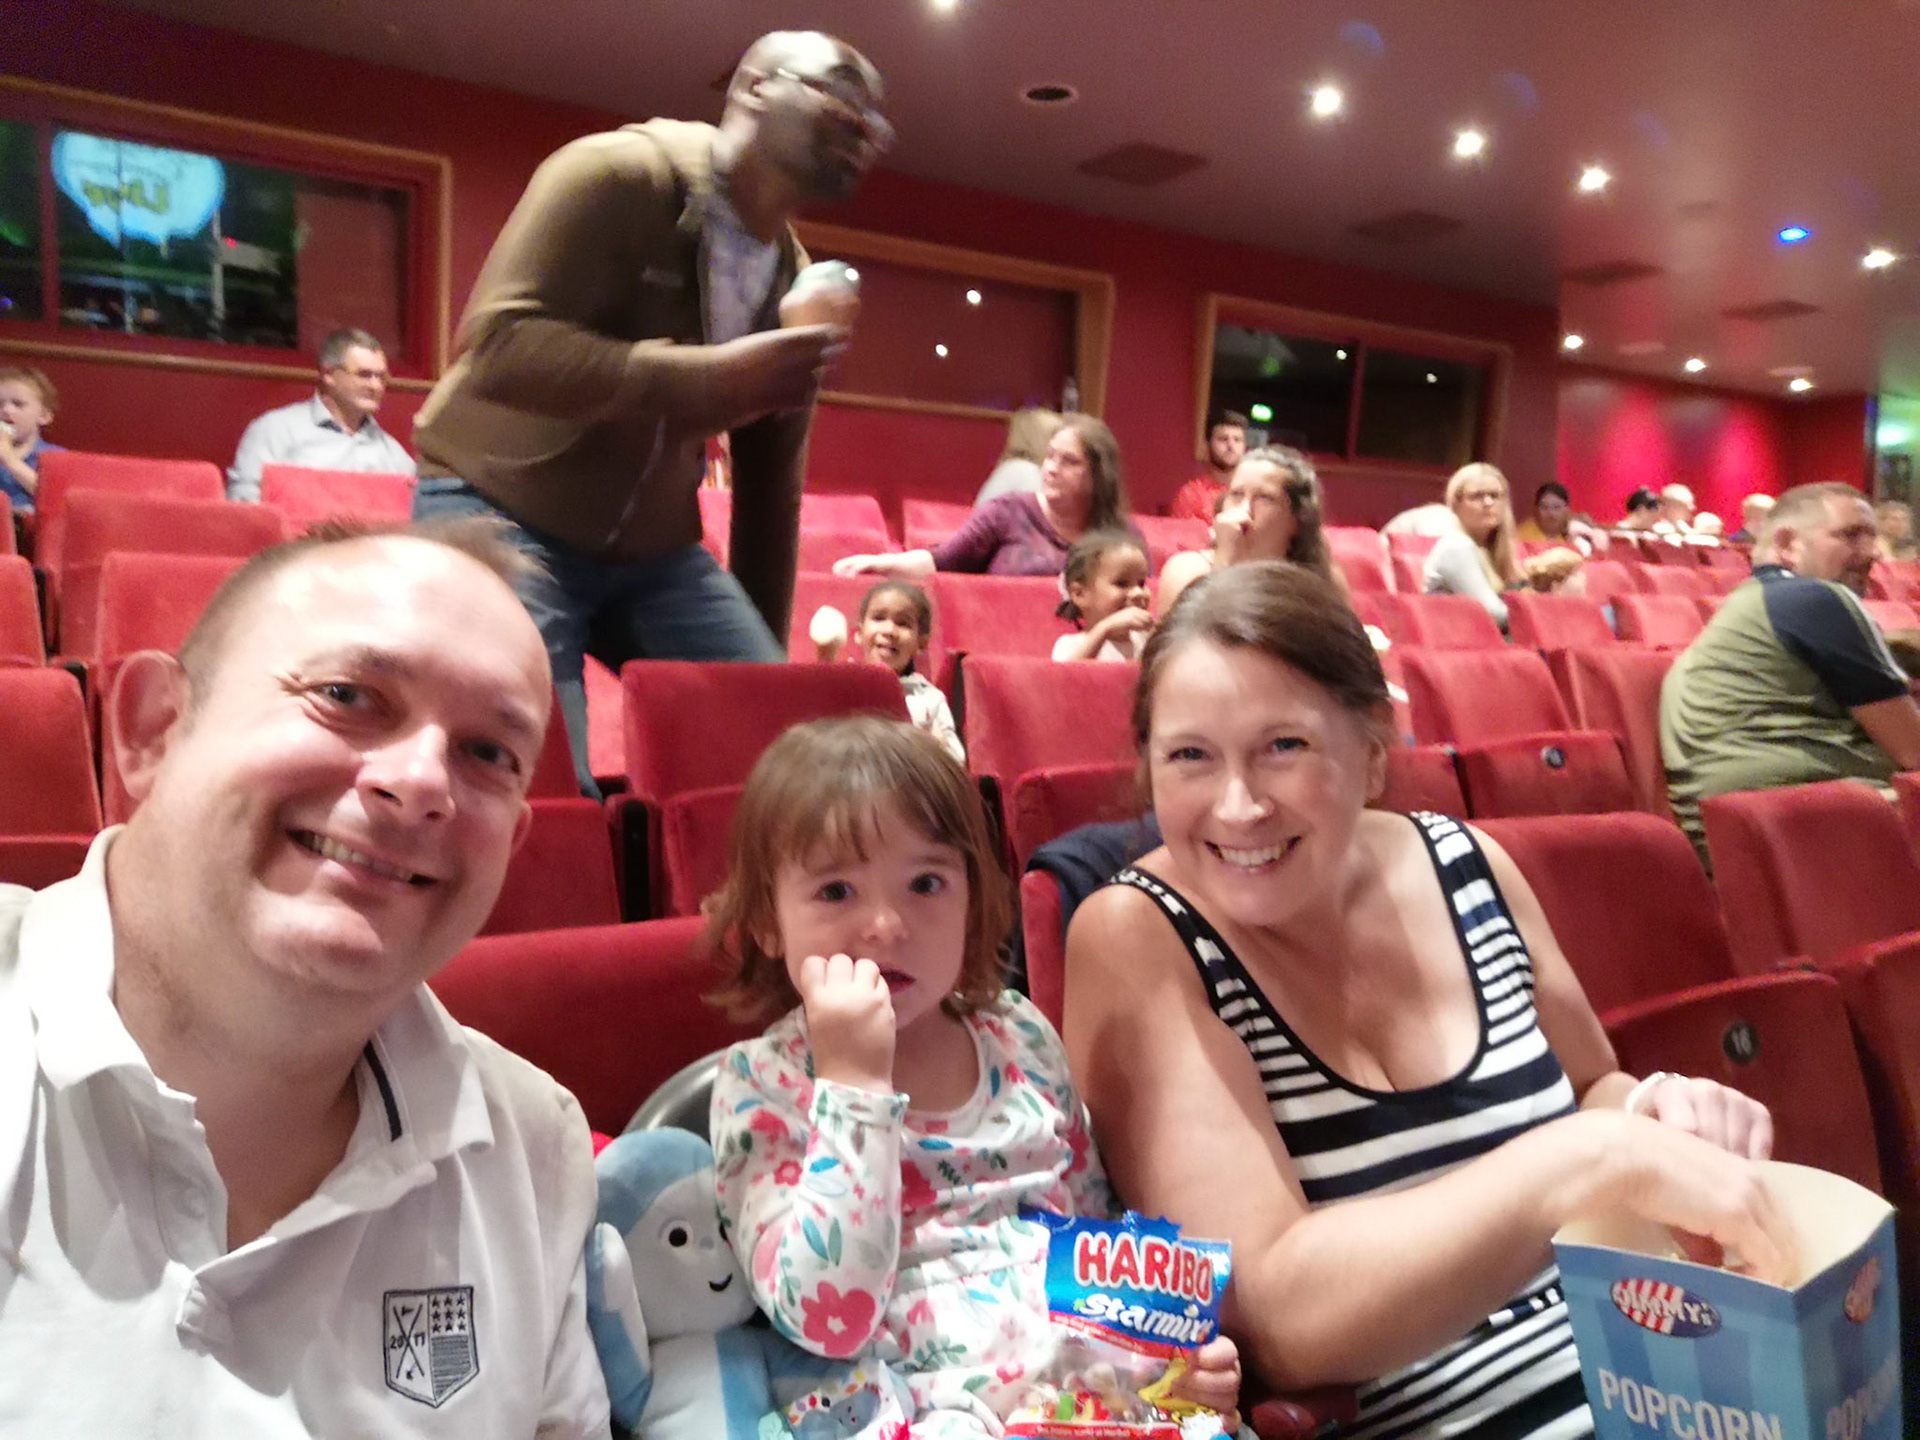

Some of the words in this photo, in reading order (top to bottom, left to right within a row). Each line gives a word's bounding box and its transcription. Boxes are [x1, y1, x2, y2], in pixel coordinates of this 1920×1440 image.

[1075, 1232, 1213, 1305] HARIBO
[1079, 1293, 1214, 1343] Starmix
[1598, 1367, 1782, 1440] POPCORN
